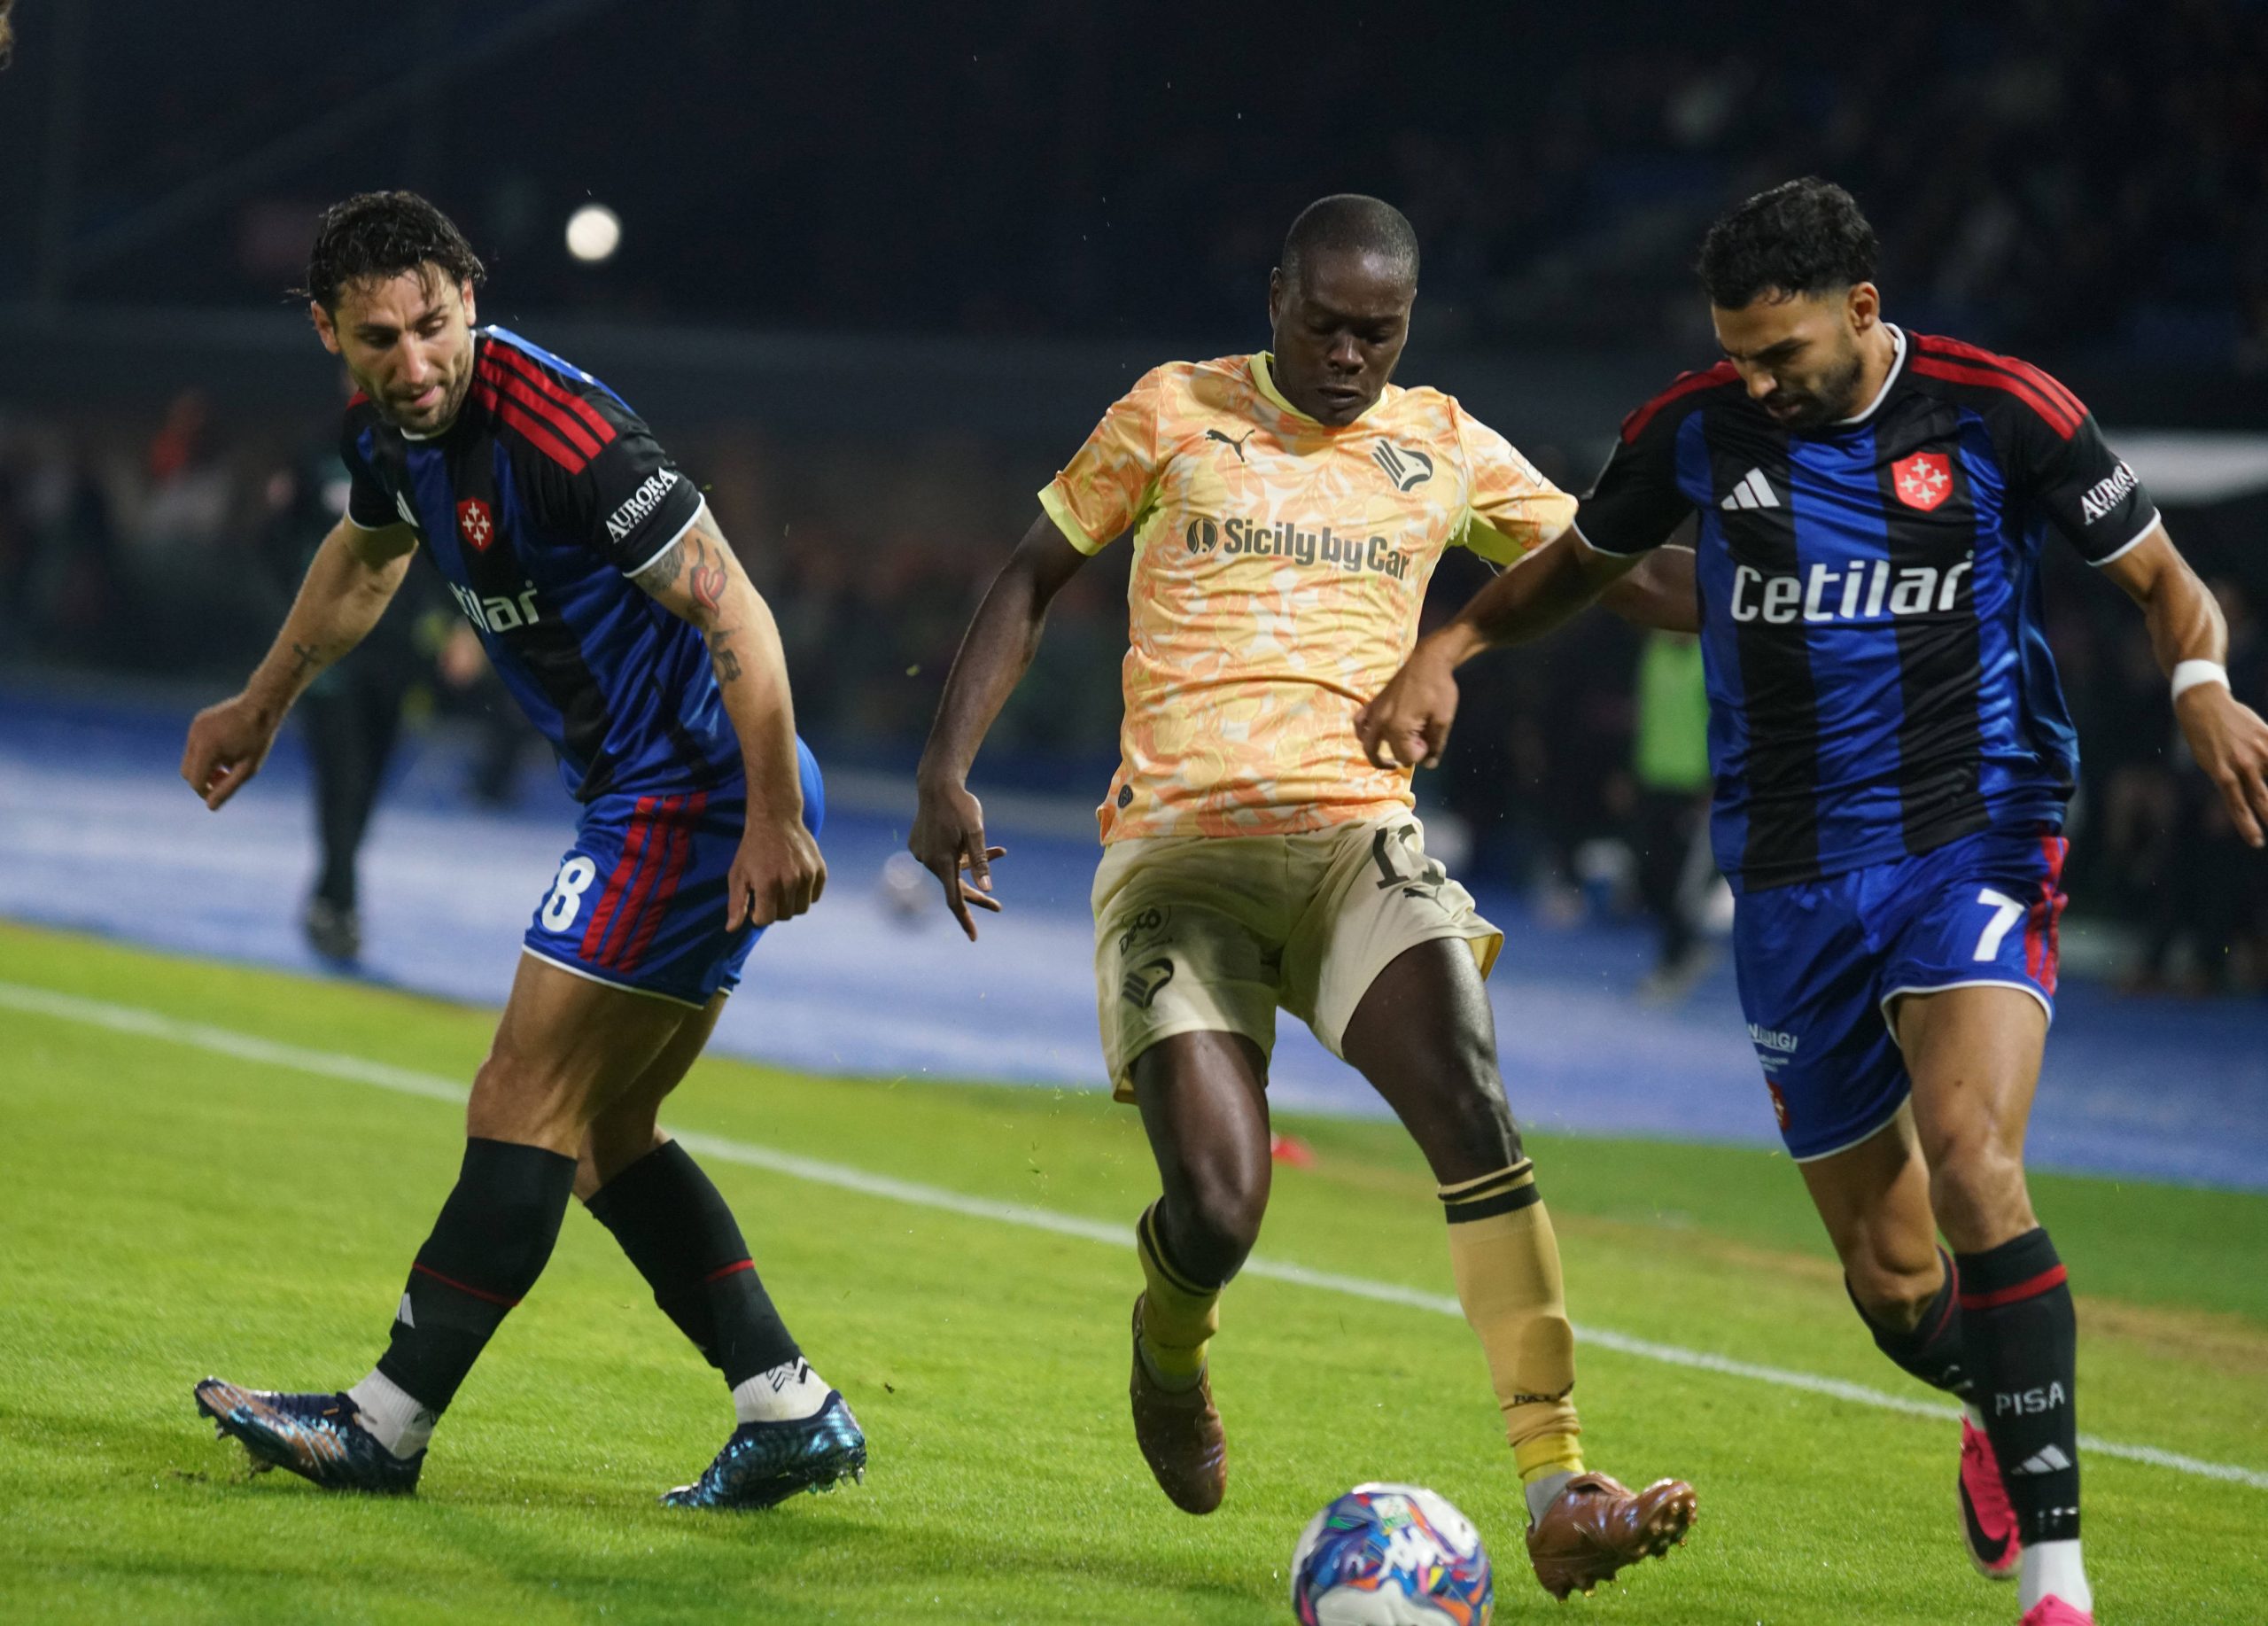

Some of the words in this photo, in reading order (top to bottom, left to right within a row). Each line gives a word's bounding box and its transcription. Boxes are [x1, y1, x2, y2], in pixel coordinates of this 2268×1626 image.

[605, 466, 679, 543] AURORA
[541, 856, 596, 932] 8
[1972, 888, 2025, 962] 7
[1996, 1381, 2066, 1416] PISA
